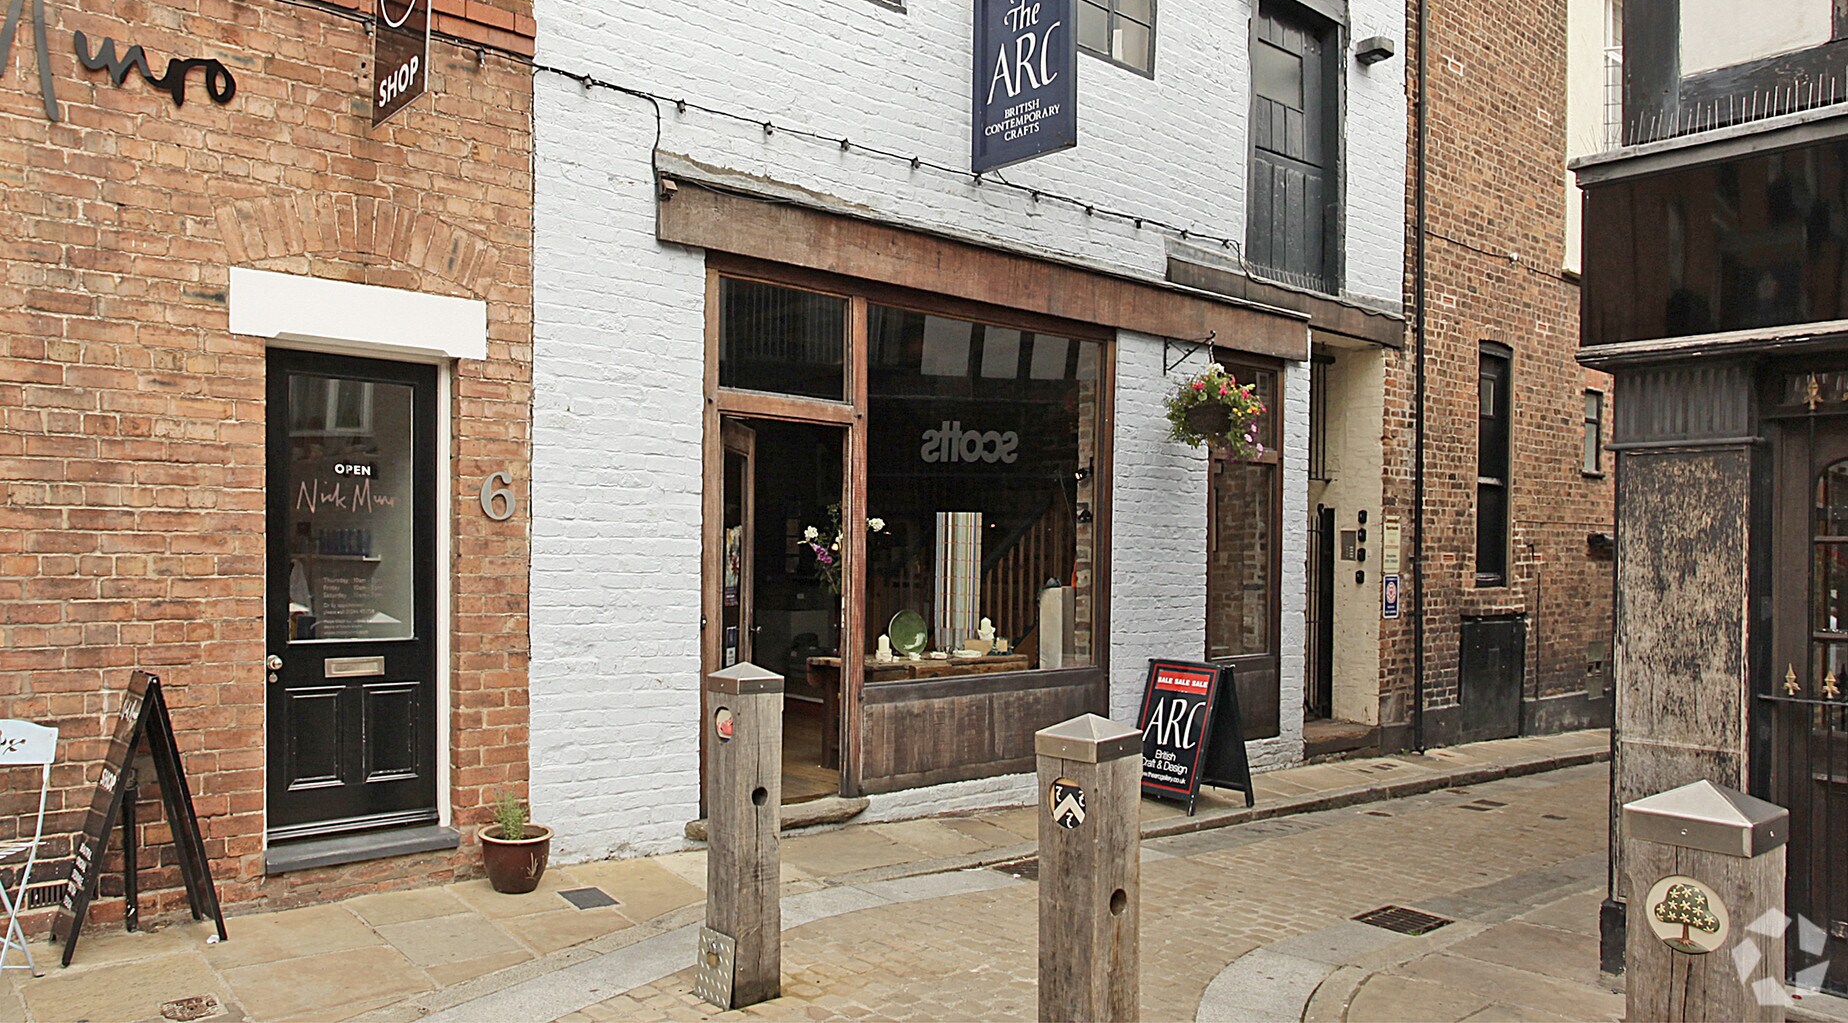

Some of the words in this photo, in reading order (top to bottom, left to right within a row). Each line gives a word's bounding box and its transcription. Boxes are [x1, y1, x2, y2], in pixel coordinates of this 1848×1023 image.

[987, 21, 1061, 105] ARC
[378, 55, 419, 107] SHOP
[985, 103, 1060, 136] CONTEMPORARY
[1004, 98, 1040, 119] BRITISH
[1004, 122, 1040, 141] CRAFTS
[334, 463, 371, 476] OPEN
[296, 478, 346, 513] Nick
[480, 471, 516, 520] 6
[1157, 676, 1173, 684] SALE
[1174, 678, 1190, 686] SALE
[1191, 680, 1209, 688] SALE
[1142, 697, 1206, 749] ARC
[1155, 749, 1176, 762] British
[1156, 759, 1163, 770] &
[1163, 761, 1188, 775] Design
